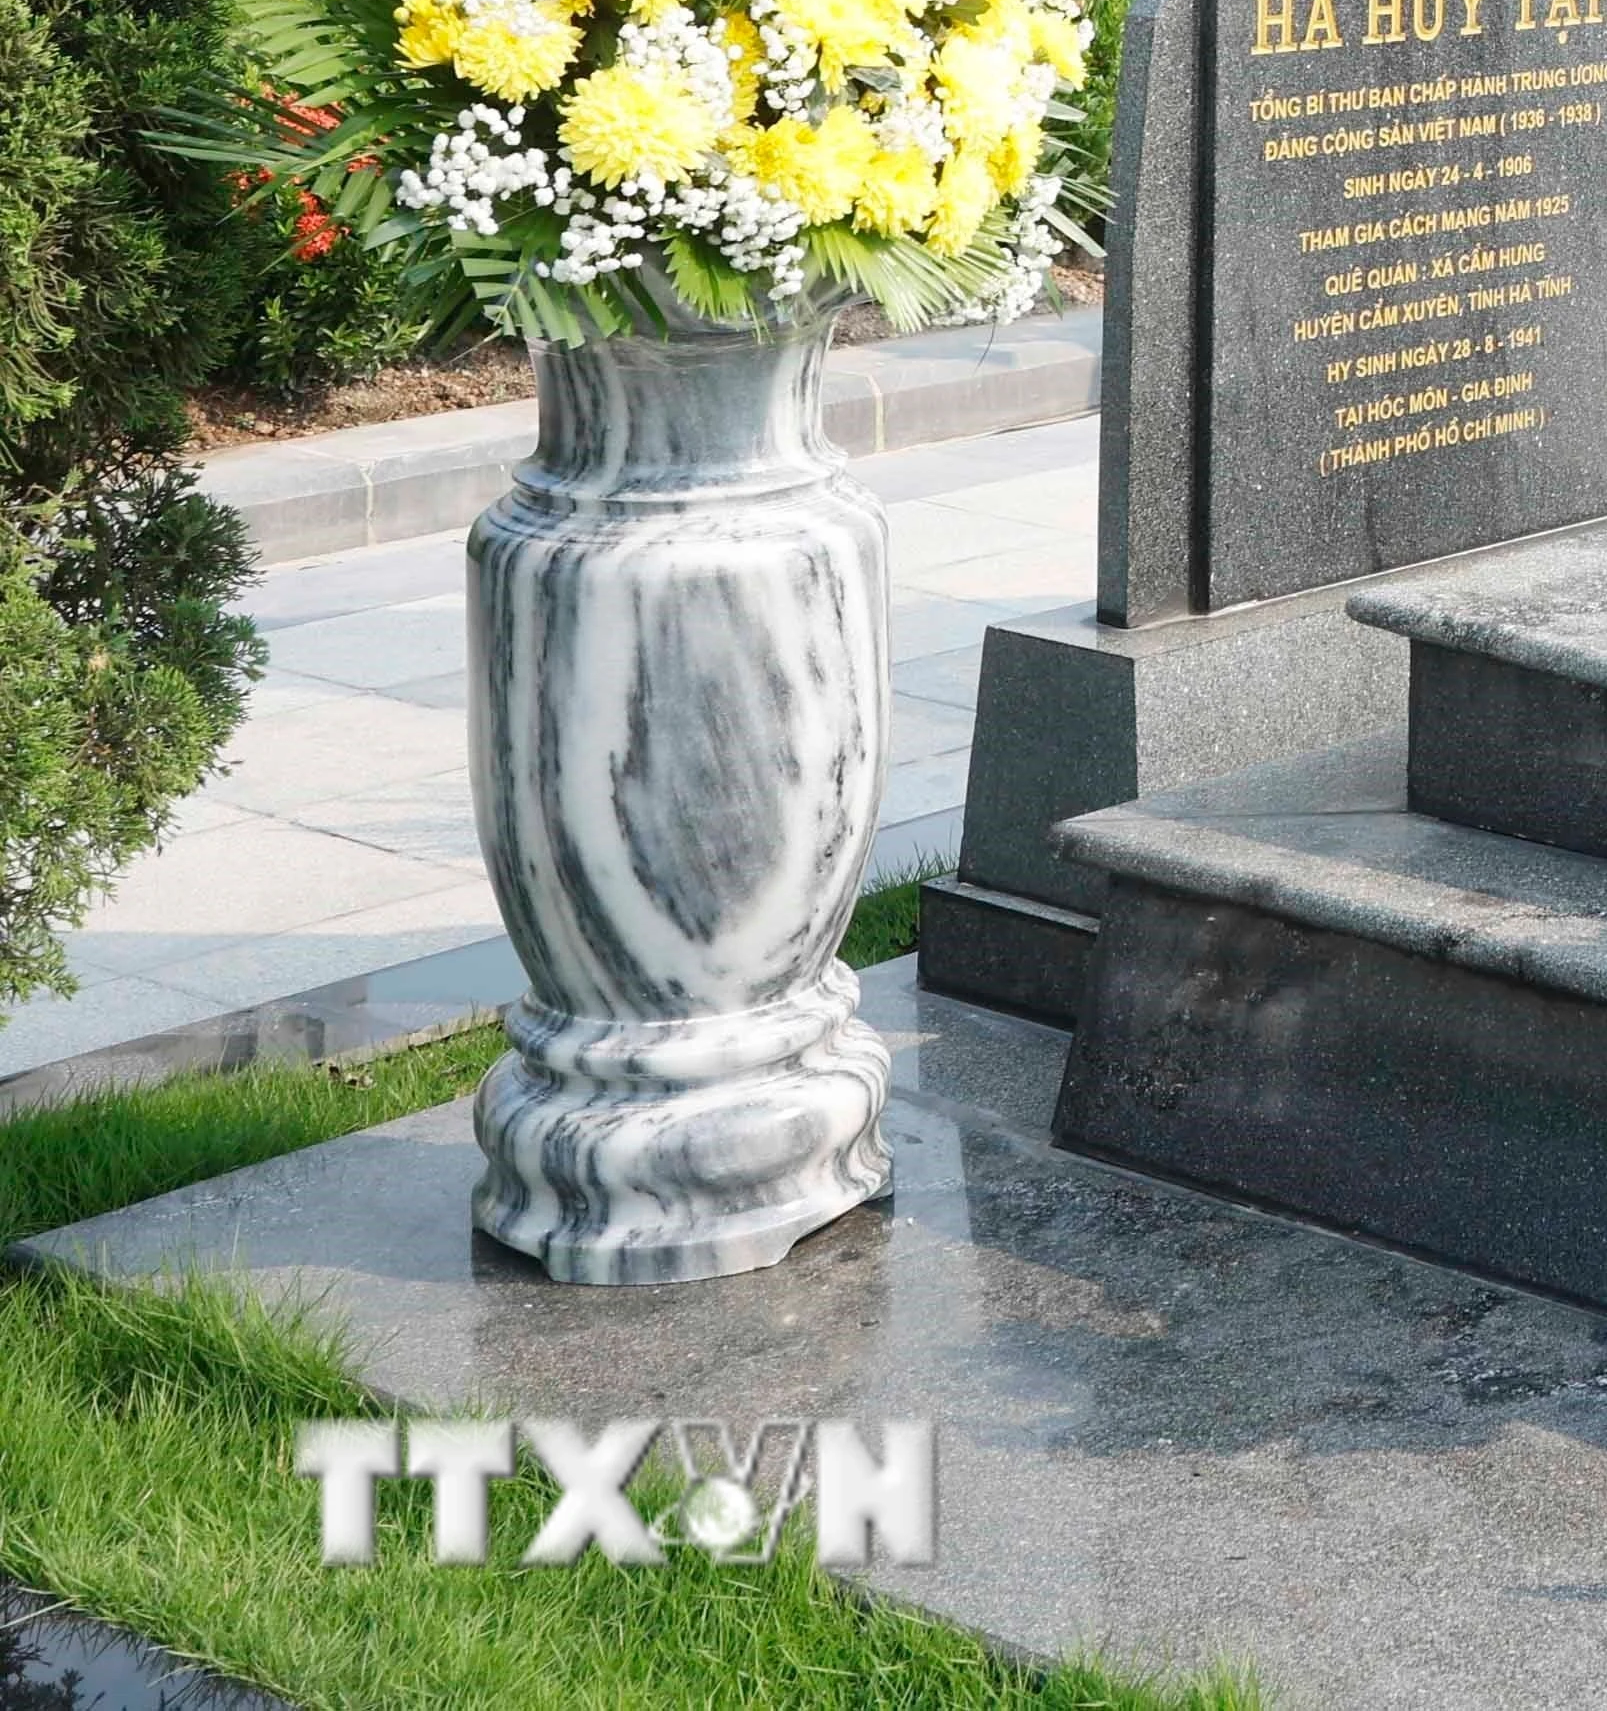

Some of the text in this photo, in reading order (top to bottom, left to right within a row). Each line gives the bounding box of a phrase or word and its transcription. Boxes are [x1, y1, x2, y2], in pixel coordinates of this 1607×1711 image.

[1250, 89, 1301, 121] TỔNG
[1306, 89, 1326, 115] BÍ
[1328, 87, 1366, 113] THƯ
[1369, 85, 1404, 108] BAN
[1410, 73, 1456, 104] CHẤP
[1460, 71, 1507, 97] HÀNH
[1511, 68, 1566, 91] TRUNG
[1264, 132, 1318, 161] ĐẢNG
[1322, 127, 1374, 157] CỘNG
[1379, 119, 1414, 146] SẢN
[1418, 116, 1455, 145] VIỆT
[1459, 114, 1496, 137] NAM
[1511, 108, 1545, 130] 1936
[1559, 103, 1592, 127] 1938
[1344, 174, 1384, 199] SINH
[1389, 163, 1436, 191] NGÀY
[1440, 165, 1460, 185] 24
[1473, 162, 1484, 181] 4
[1497, 155, 1532, 177] 1906
[1300, 194, 1569, 253] THAM GIA CÁCH MẠNG NĂM 1925
[1325, 265, 1363, 296] QUÊ
[1367, 260, 1417, 290] QUÁN
[1432, 253, 1455, 279] XÃ
[1499, 243, 1545, 267] HƯNG
[1509, 276, 1530, 304] HÀ
[1535, 274, 1572, 298] TĨNH
[1327, 360, 1352, 383] HY
[1355, 356, 1396, 378] SINH
[1401, 339, 1449, 370] NGÀY
[1452, 339, 1471, 360] 28
[1485, 335, 1494, 353] 8
[1508, 325, 1541, 349] 1941
[1335, 406, 1363, 431] TẠI
[1368, 393, 1405, 422] HÓC
[1409, 386, 1447, 414] MÔN
[1461, 379, 1490, 403] GIA
[1494, 372, 1533, 399] ĐỊNH
[1331, 439, 1390, 469] THÀNH
[1395, 421, 1431, 455] PHỐ
[1435, 417, 1460, 447] HỒ
[1463, 411, 1492, 440] CHÍ
[1495, 408, 1535, 434] MINH
